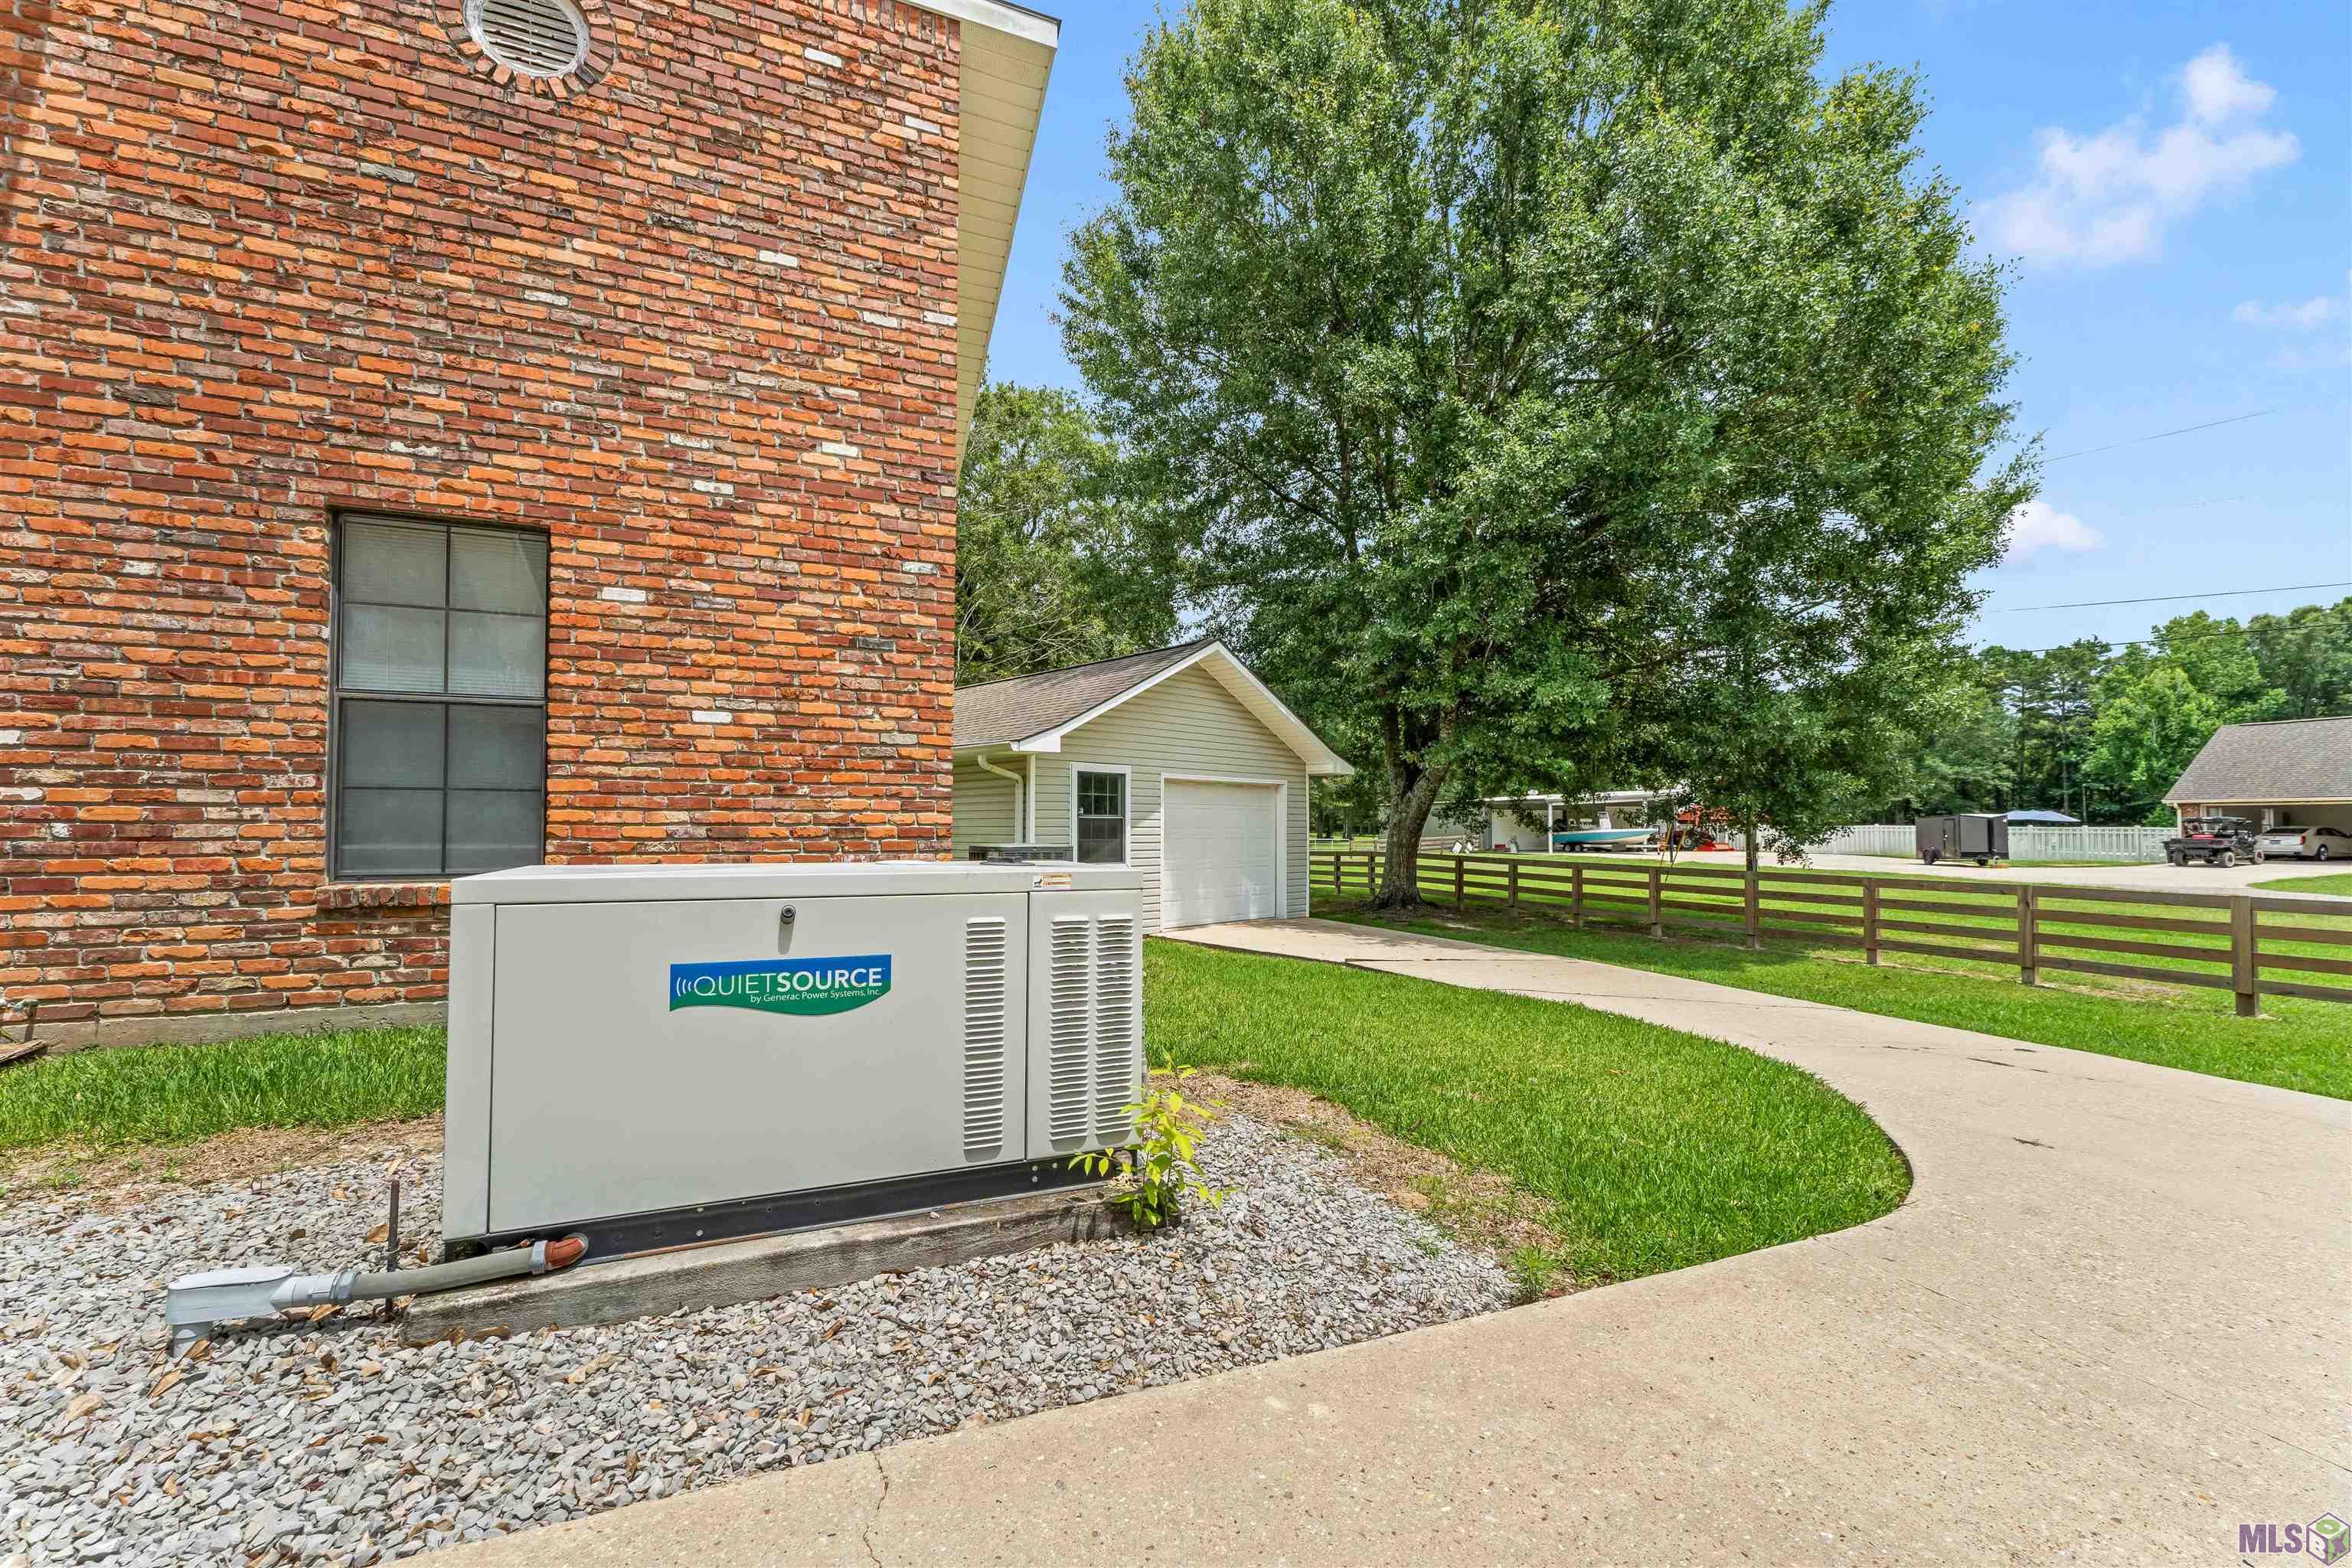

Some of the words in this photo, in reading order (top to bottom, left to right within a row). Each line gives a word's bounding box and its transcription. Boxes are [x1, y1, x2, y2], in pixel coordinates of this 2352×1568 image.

[694, 968, 883, 996] QUIETSOURCE
[750, 995, 762, 1004] by
[763, 993, 800, 1002] Generac
[802, 991, 828, 1000] Power
[830, 989, 866, 999] Systems,
